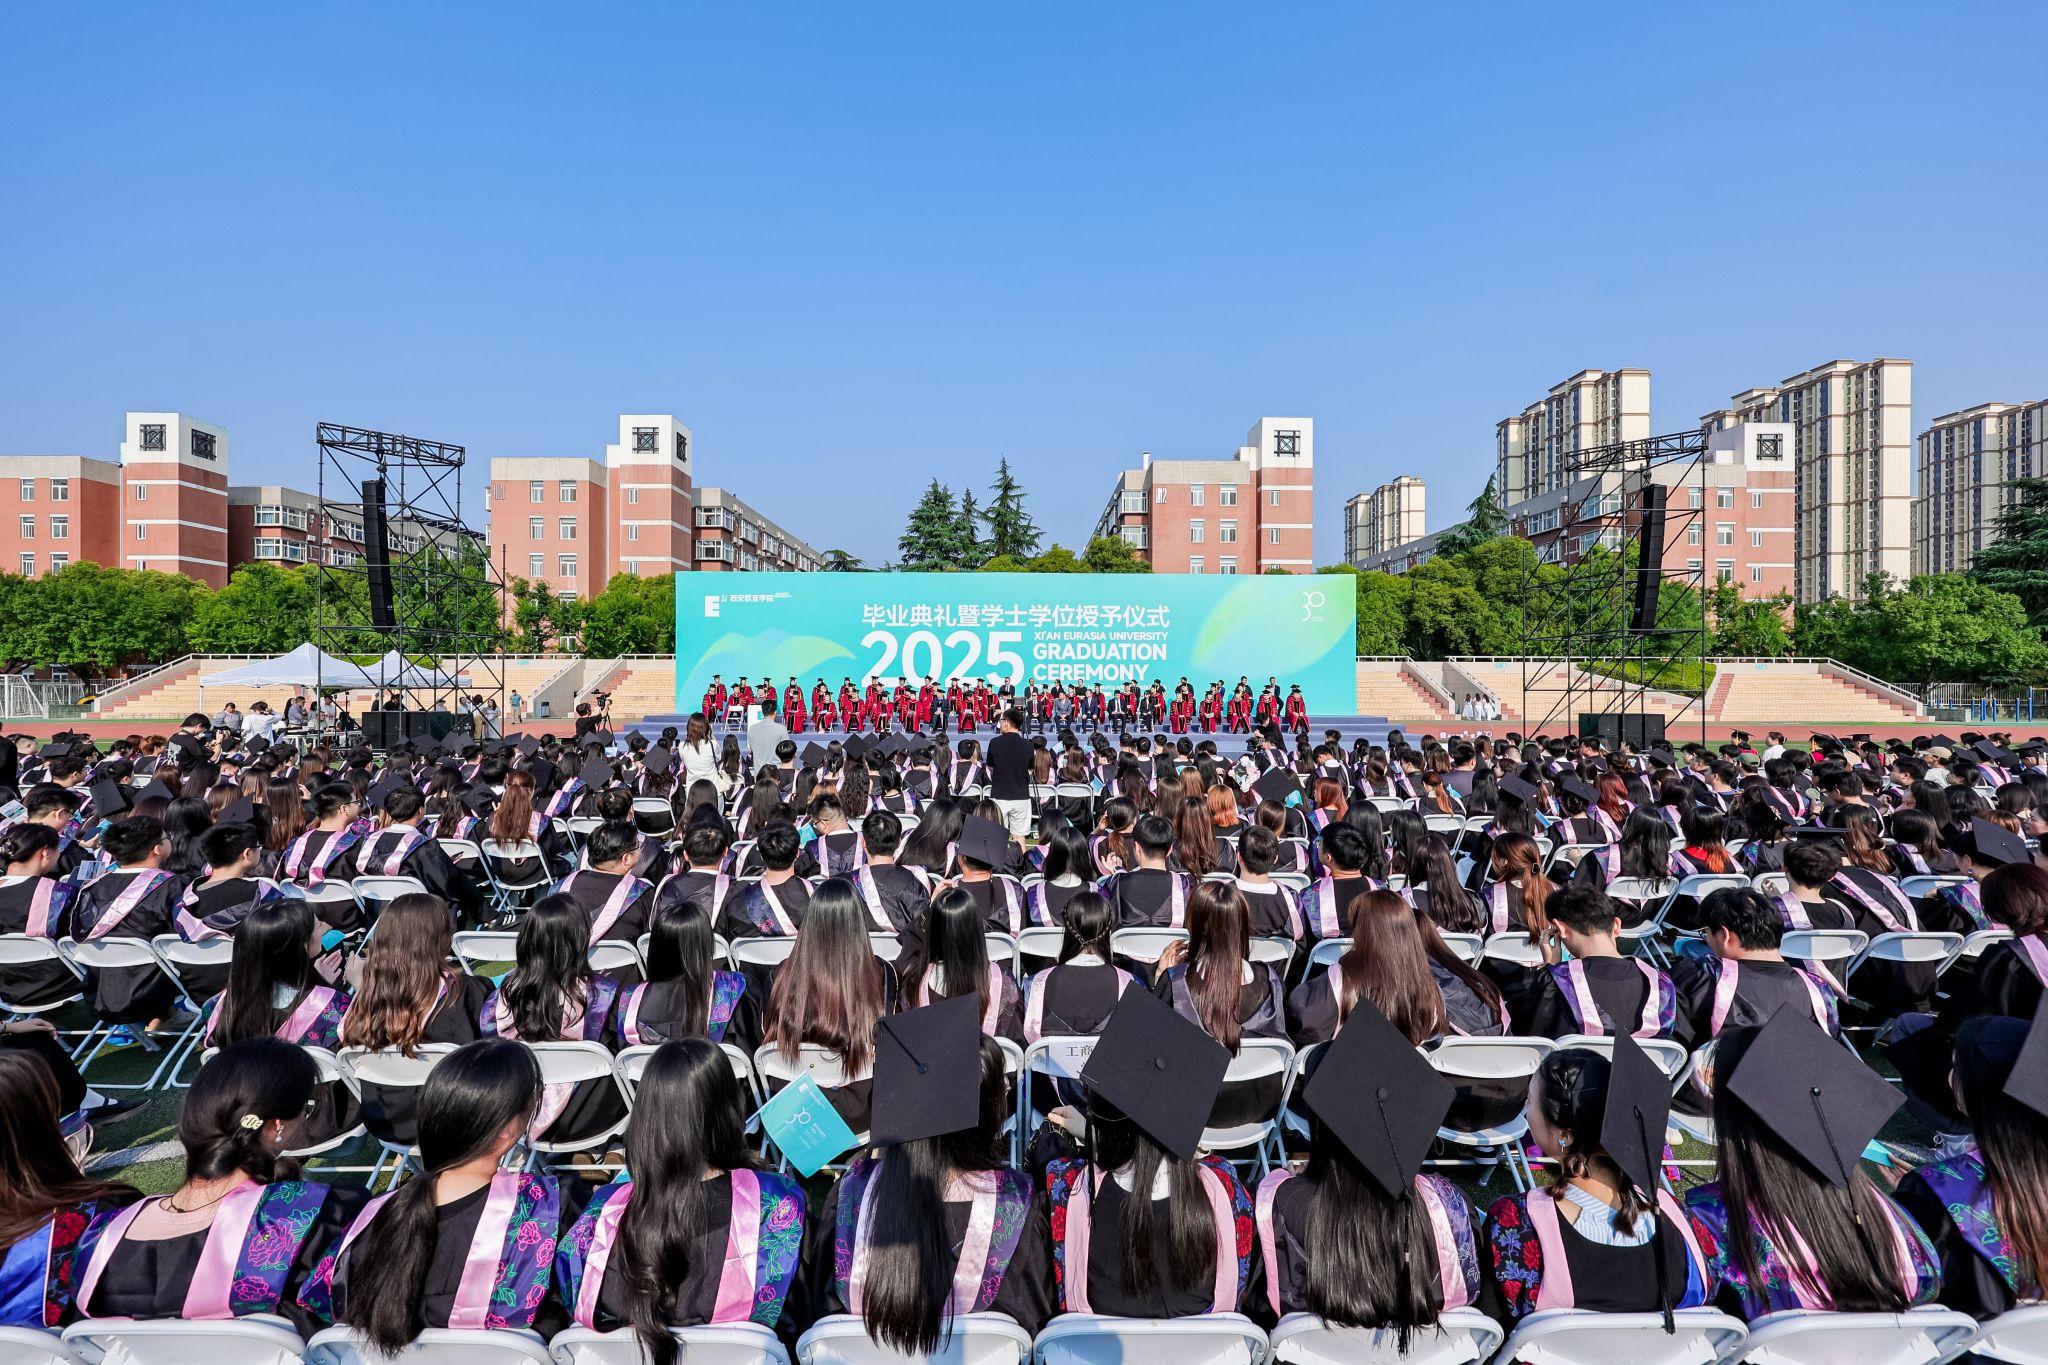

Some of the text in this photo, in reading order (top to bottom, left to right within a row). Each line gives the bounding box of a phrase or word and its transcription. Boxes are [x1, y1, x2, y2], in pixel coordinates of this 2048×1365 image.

[862, 603, 1170, 628] 毕业典礼暨学士学位授予仪式
[1034, 631, 1169, 641] XI'AN EURASIA UNIVERSITY
[861, 631, 1025, 687] 2025
[1033, 643, 1167, 661] GRADUATION
[1033, 663, 1149, 681] CEREMONY
